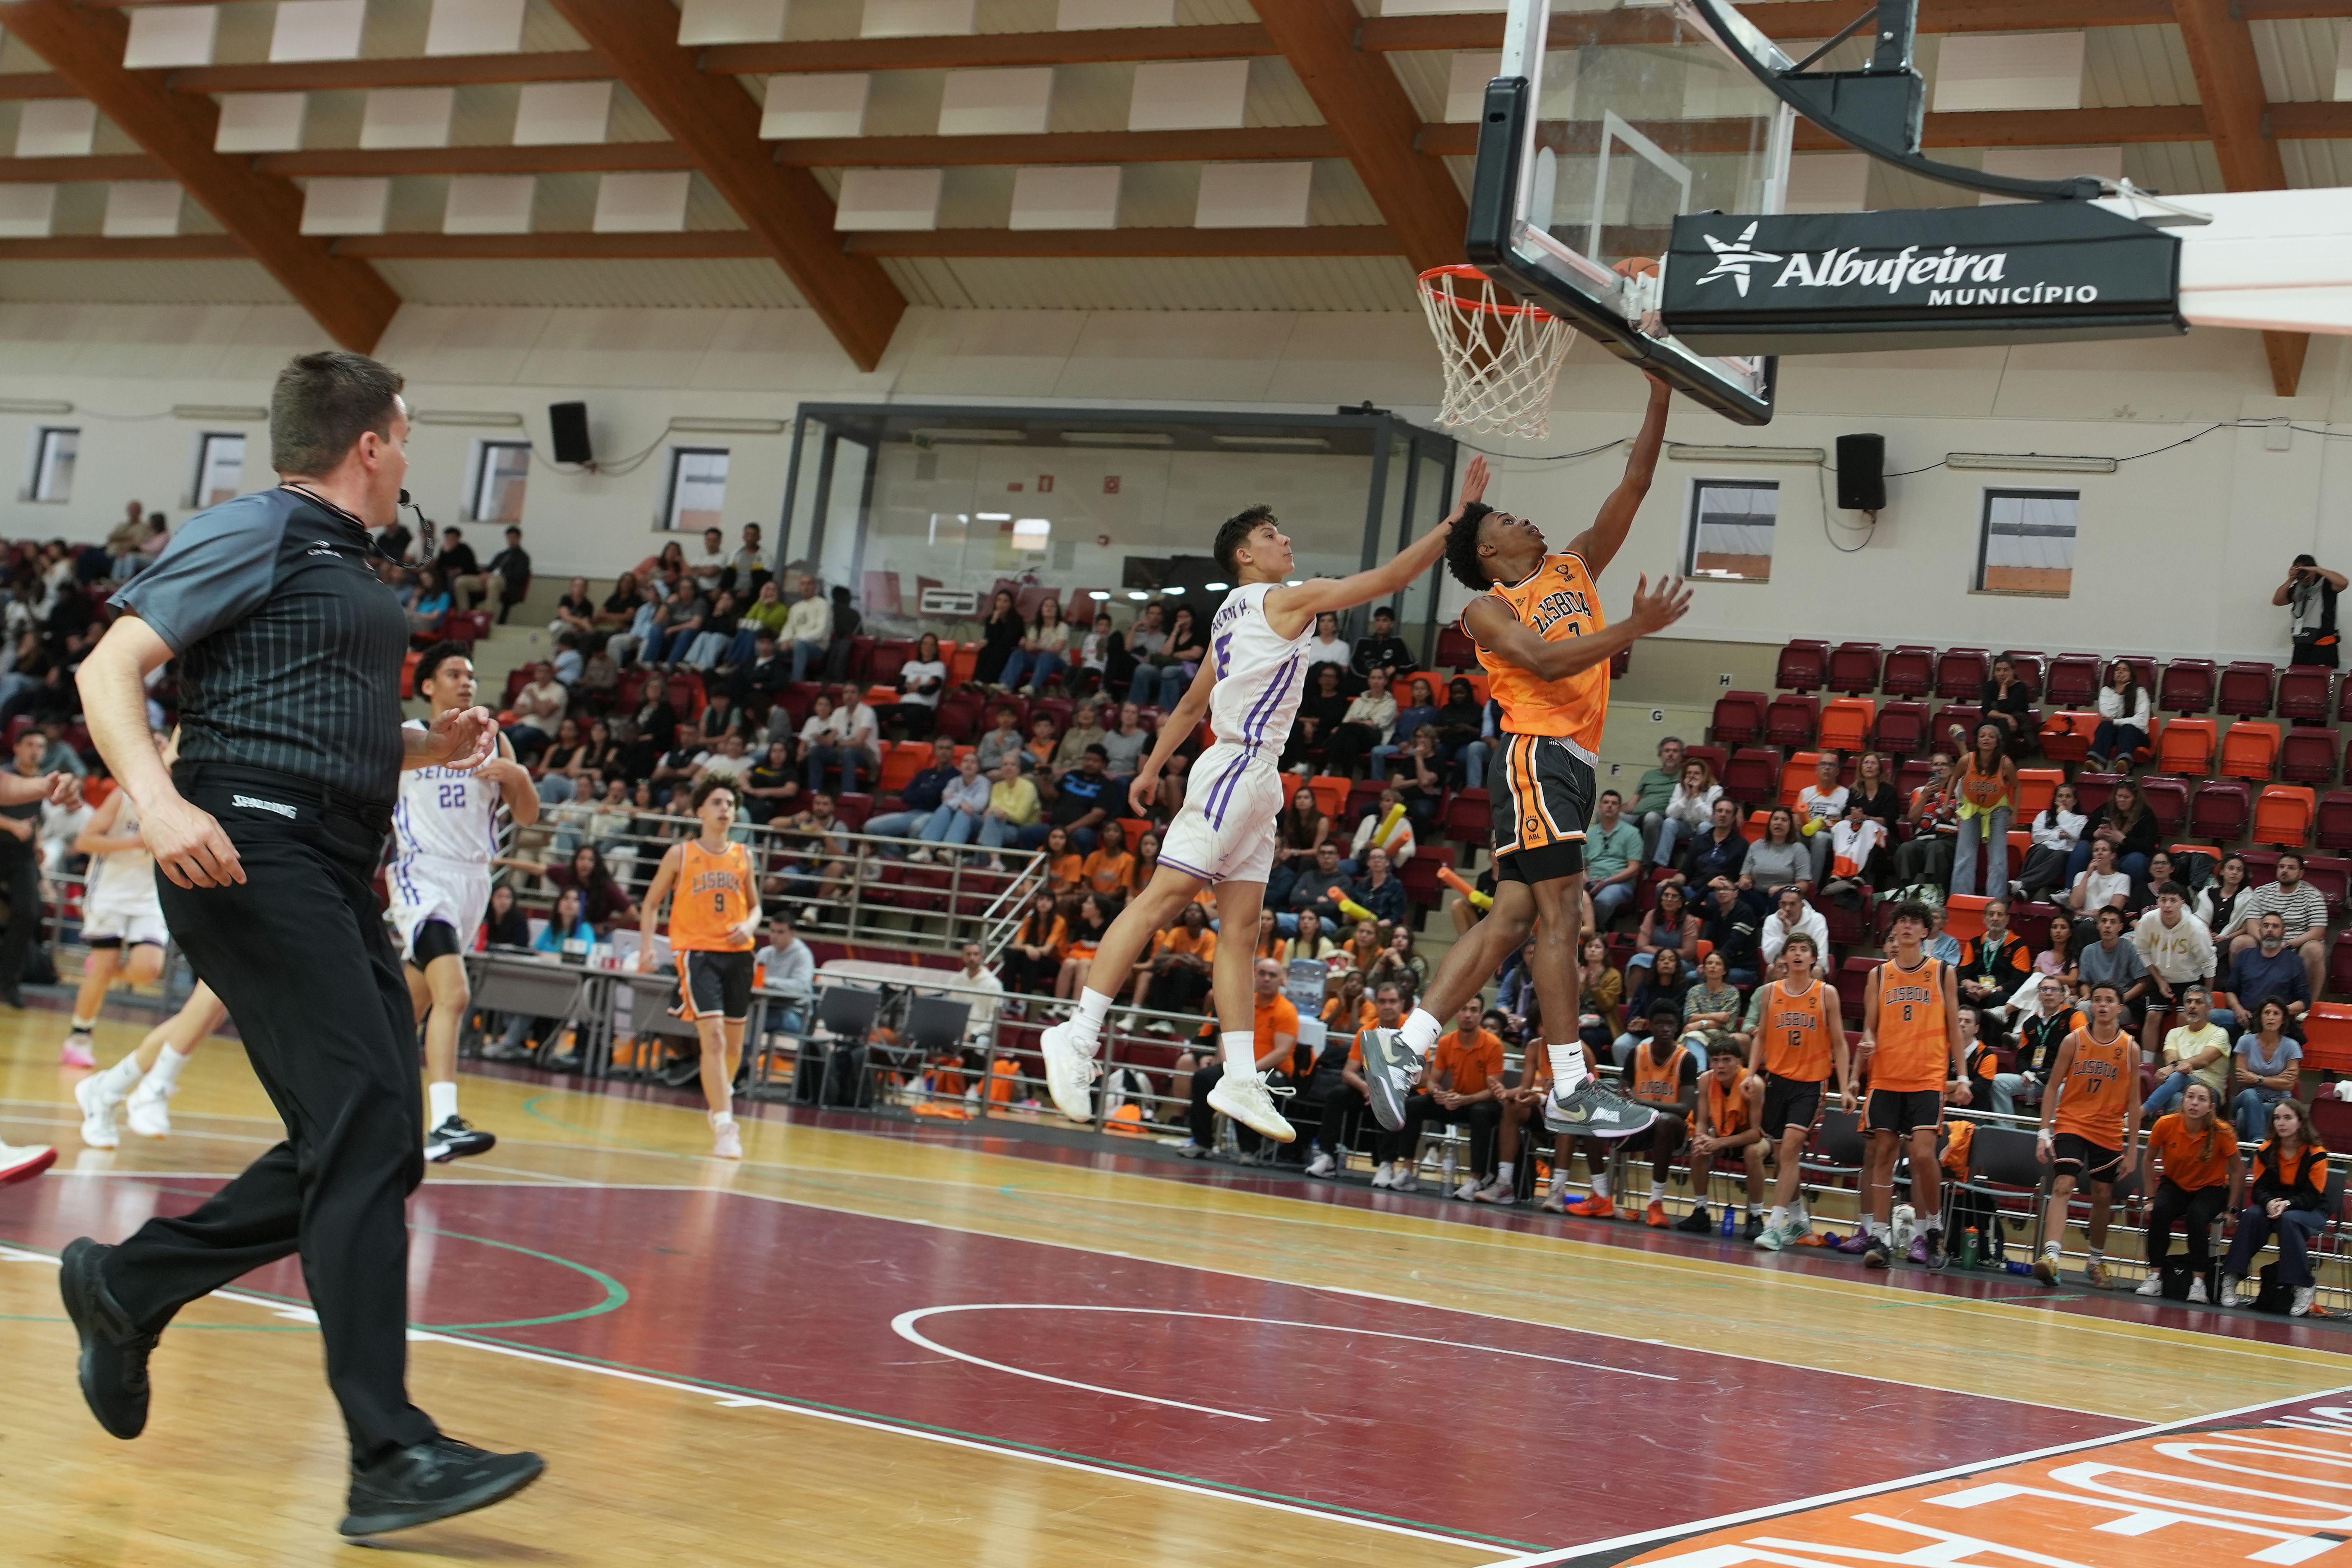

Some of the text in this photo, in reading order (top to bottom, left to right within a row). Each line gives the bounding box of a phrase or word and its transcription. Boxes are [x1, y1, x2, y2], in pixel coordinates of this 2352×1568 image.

[1772, 245, 2008, 294] Albufeira
[1927, 281, 2098, 306] MUNICÍPIO
[1563, 573, 1576, 583] ABL
[1531, 590, 1592, 637] LISBOA
[1720, 675, 1729, 685] H
[1652, 710, 1662, 721] G
[1611, 764, 1620, 776] F
[439, 784, 466, 808] 22
[1529, 833, 1541, 841] ABL
[714, 893, 724, 912] 9
[1885, 986, 1931, 1006] LISBOA
[1774, 1012, 1816, 1031] LISBOA
[1903, 1005, 1912, 1022] 8
[1788, 1030, 1801, 1046] 12
[2073, 1059, 2117, 1081] LISBOA
[2087, 1078, 2102, 1094] 17
